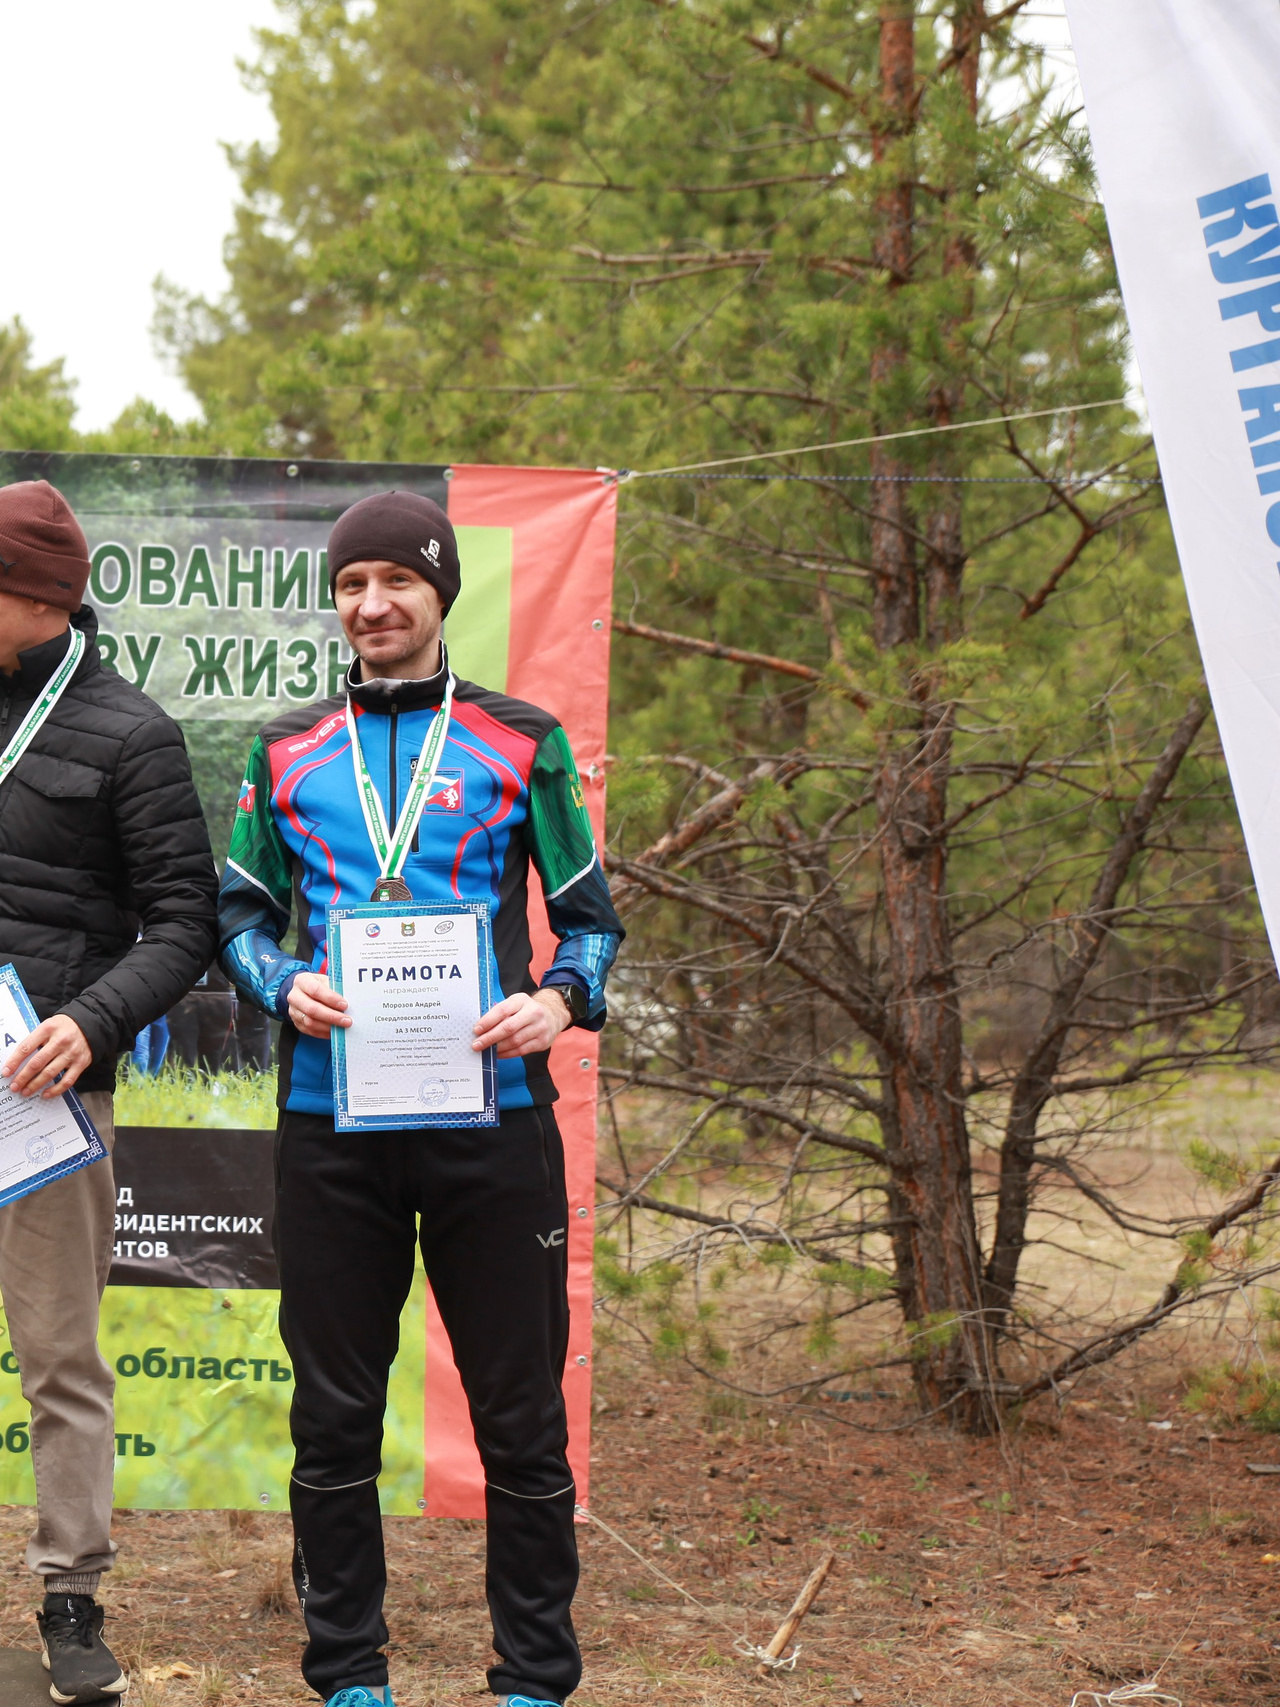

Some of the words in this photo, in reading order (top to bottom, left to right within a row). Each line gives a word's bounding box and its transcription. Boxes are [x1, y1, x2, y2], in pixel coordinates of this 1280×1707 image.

[183, 637, 356, 698] ЖИЗН
[358, 964, 462, 982] ГРАМОТА
[383, 986, 439, 995] награждается
[536, 1227, 565, 1249] VC
[116, 1347, 292, 1382] область
